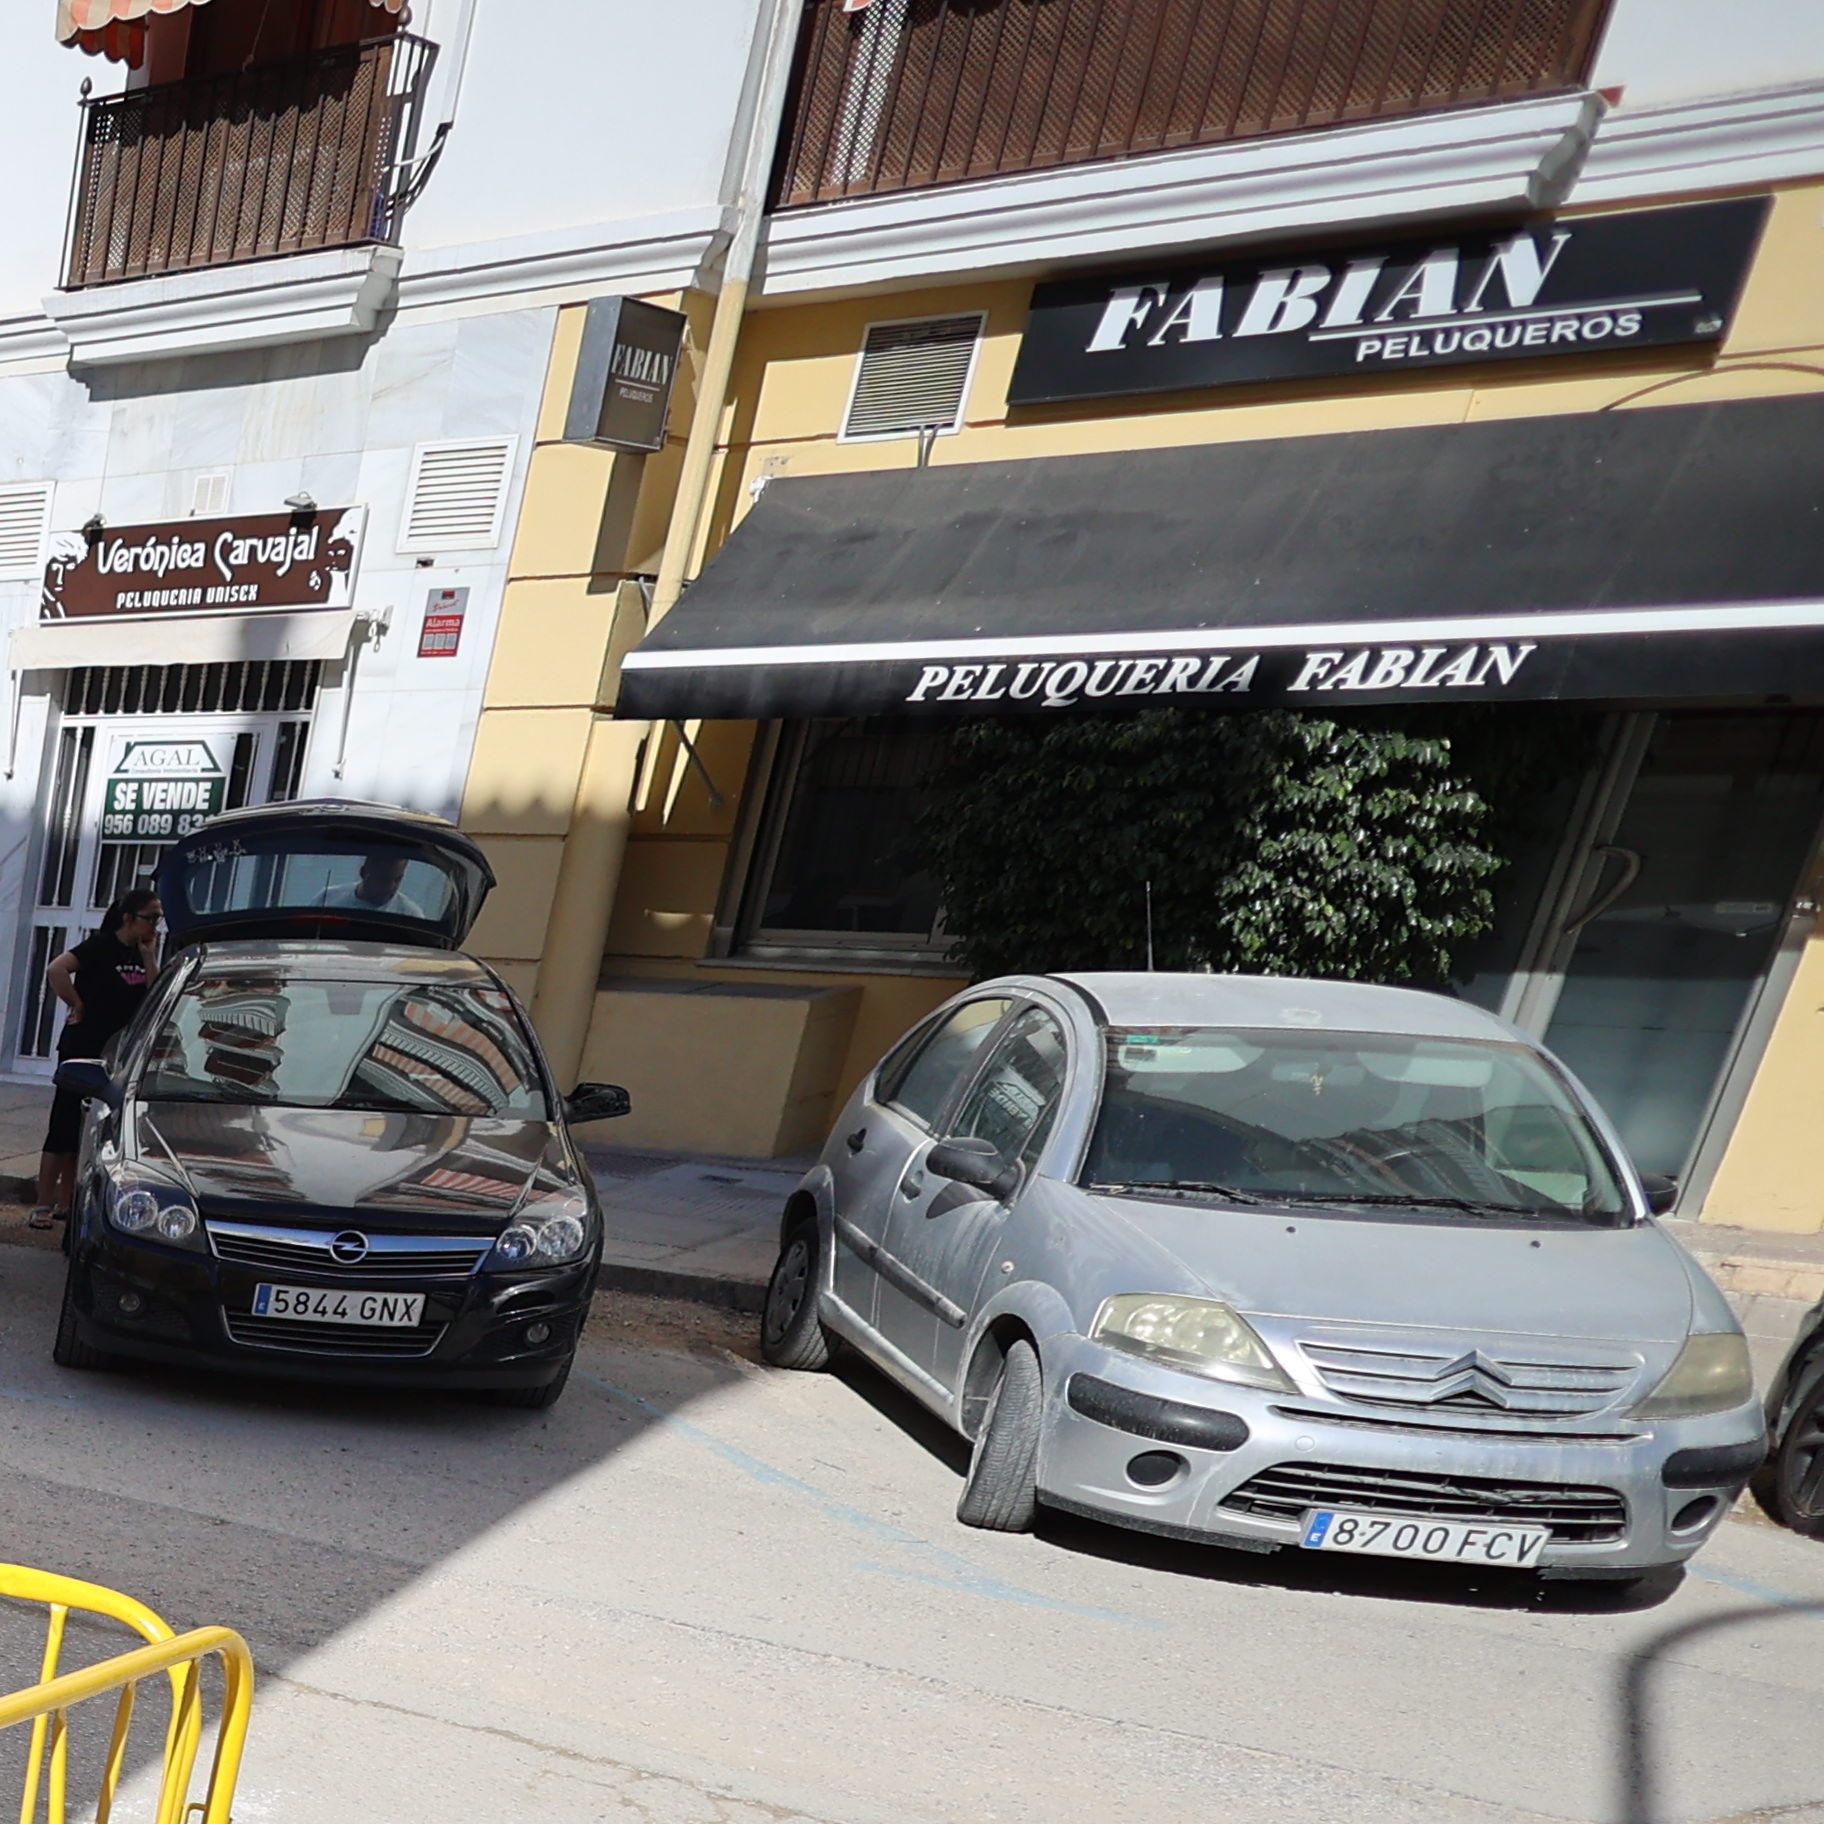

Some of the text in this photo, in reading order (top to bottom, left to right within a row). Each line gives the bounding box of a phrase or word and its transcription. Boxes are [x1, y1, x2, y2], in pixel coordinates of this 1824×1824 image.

[1085, 231, 1572, 353] FABIAN
[1354, 311, 1643, 362] PELUQUEROS
[610, 343, 674, 385] FABIAN
[96, 525, 320, 582] Verónica Carvajal
[116, 584, 259, 609] PELUQUERIA UNISEX
[426, 617, 461, 628] Alarma
[906, 644, 1538, 706] PELUQUERIA FABIAN
[133, 749, 200, 767] AGAL
[113, 781, 212, 811] SE VENDE
[104, 812, 215, 835] 956 089 83
[274, 1289, 418, 1322] 5844 GNX
[1332, 1518, 1543, 1562] 8700 FCV
